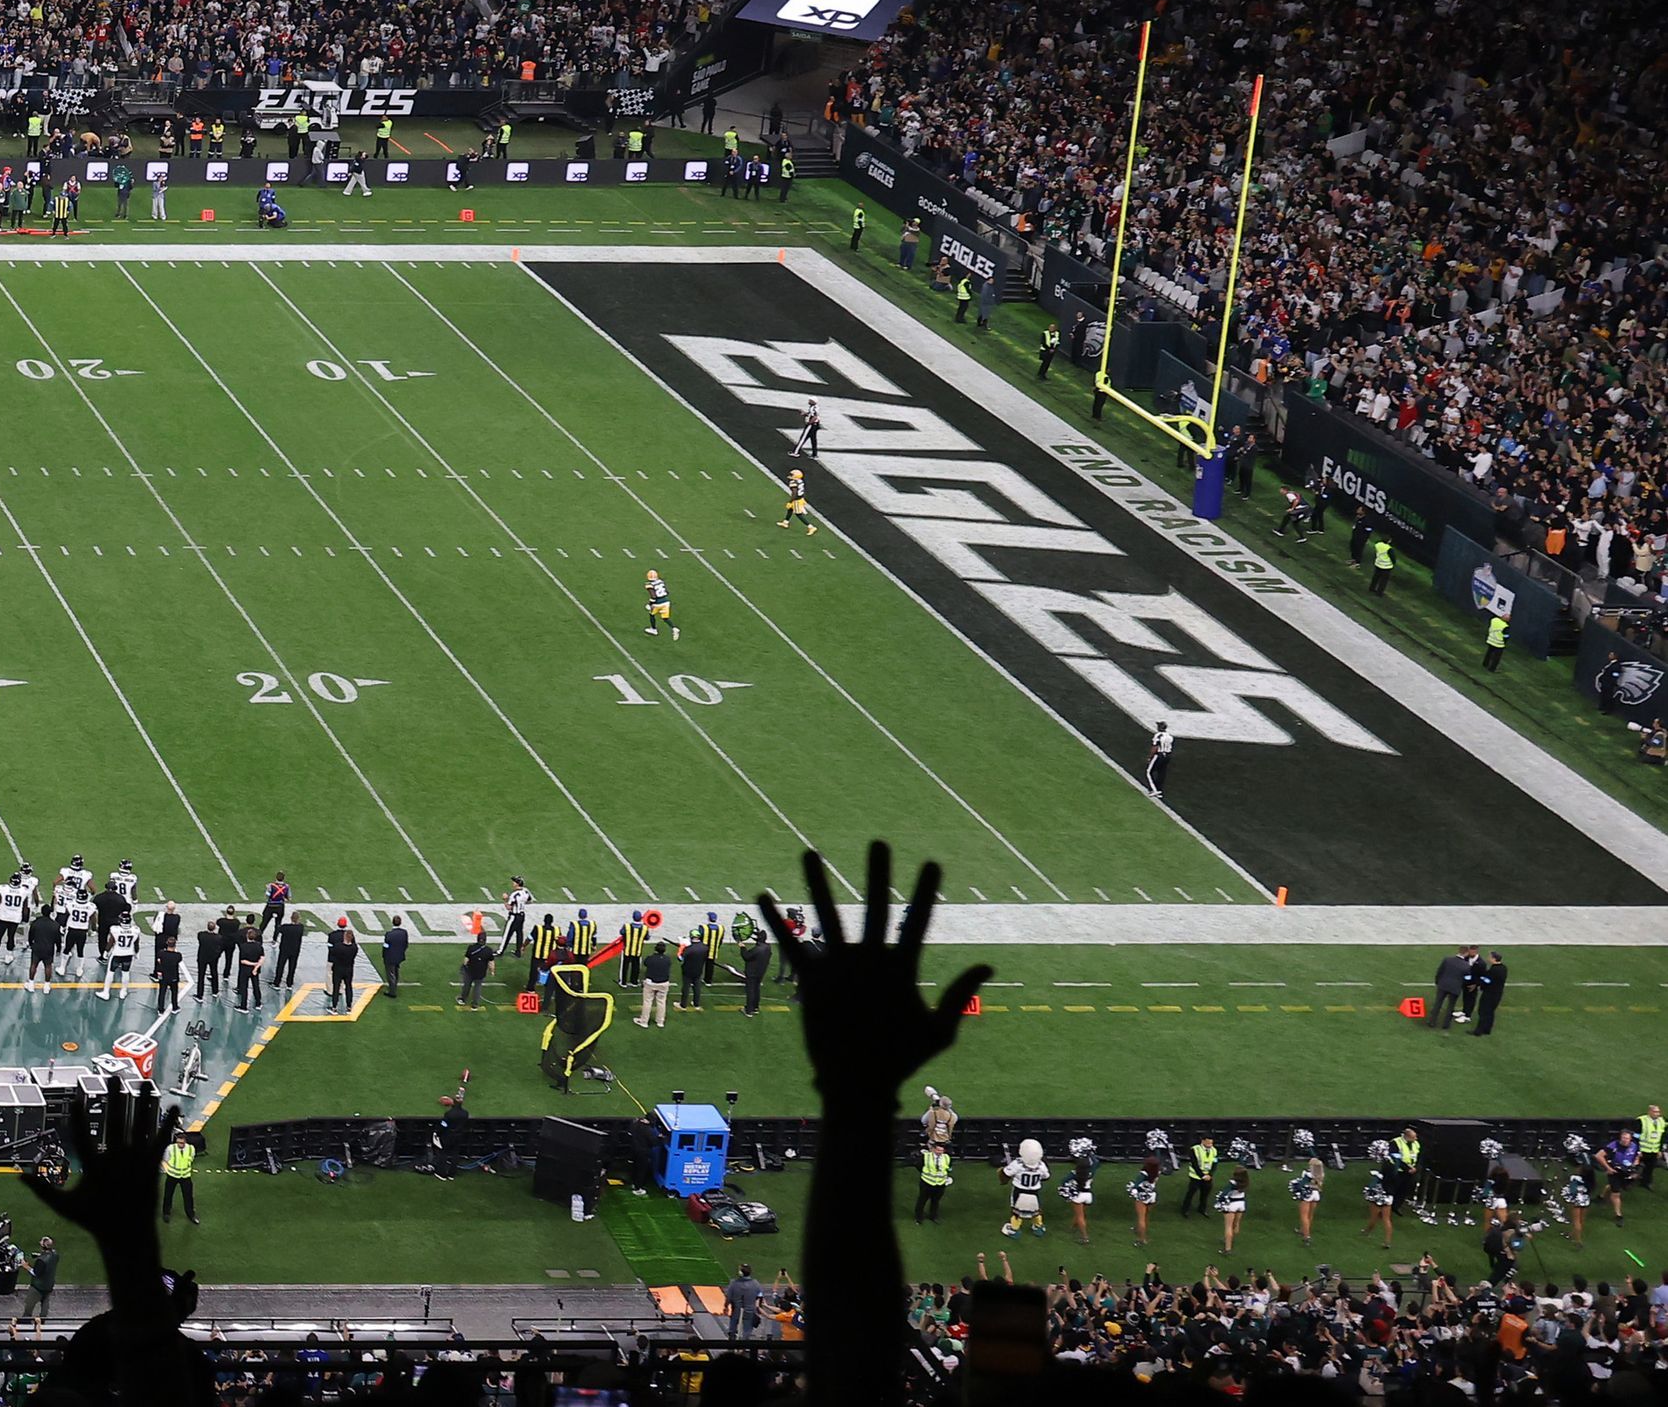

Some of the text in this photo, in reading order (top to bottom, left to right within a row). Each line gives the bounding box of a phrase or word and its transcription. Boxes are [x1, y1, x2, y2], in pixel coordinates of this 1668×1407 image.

[867, 165, 896, 189] EAGLES
[939, 234, 996, 280] EAGLES
[15, 358, 114, 380] 20
[305, 359, 408, 380] 10
[1321, 454, 1429, 532] EAGLES AUTISM
[1049, 442, 1301, 597] END RACISM
[660, 334, 1402, 758] EAGLES
[235, 670, 361, 705] 20
[592, 670, 726, 705] 10
[5, 895, 21, 908] 90
[72, 910, 88, 923] 93
[115, 935, 130, 948] 97
[521, 995, 535, 1010] 20
[1409, 1000, 1421, 1015] G
[1021, 1173, 1041, 1187] 00
